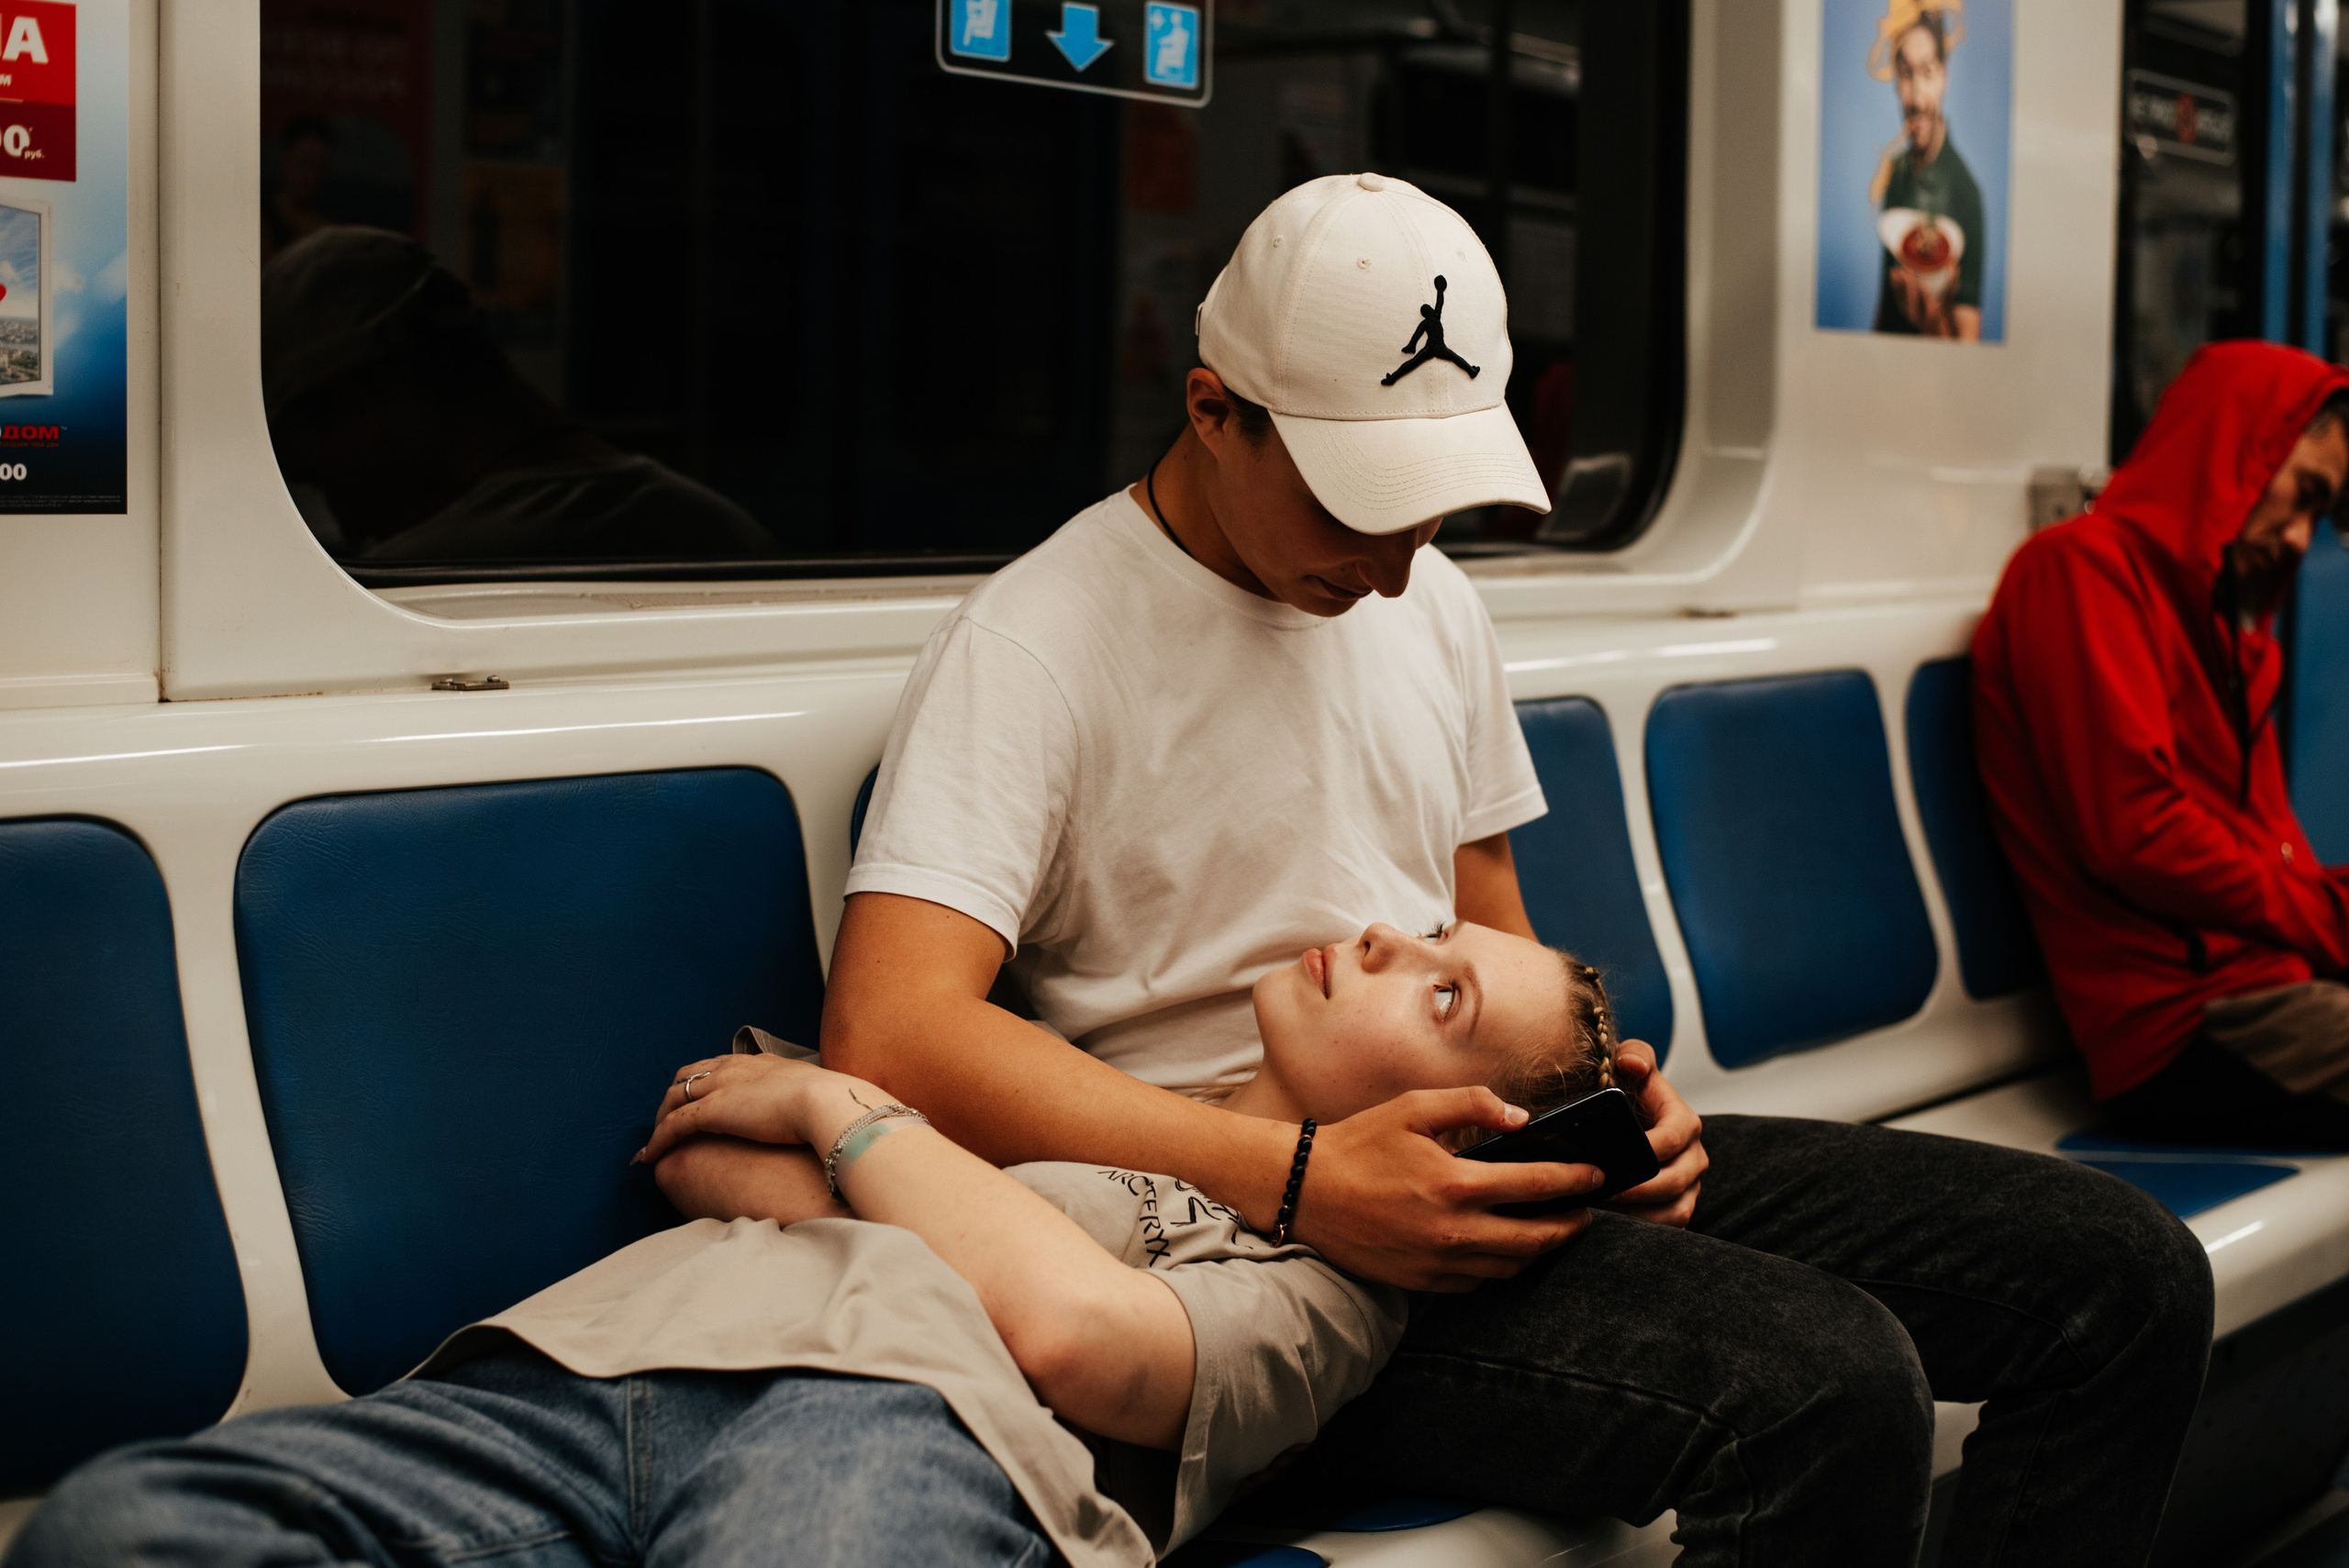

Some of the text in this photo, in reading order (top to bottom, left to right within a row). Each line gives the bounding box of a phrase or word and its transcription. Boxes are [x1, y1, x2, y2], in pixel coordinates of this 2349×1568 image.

[0, 16, 50, 64] А
[0, 125, 45, 161] 0 руб.
[0, 425, 60, 439] ДОМ
